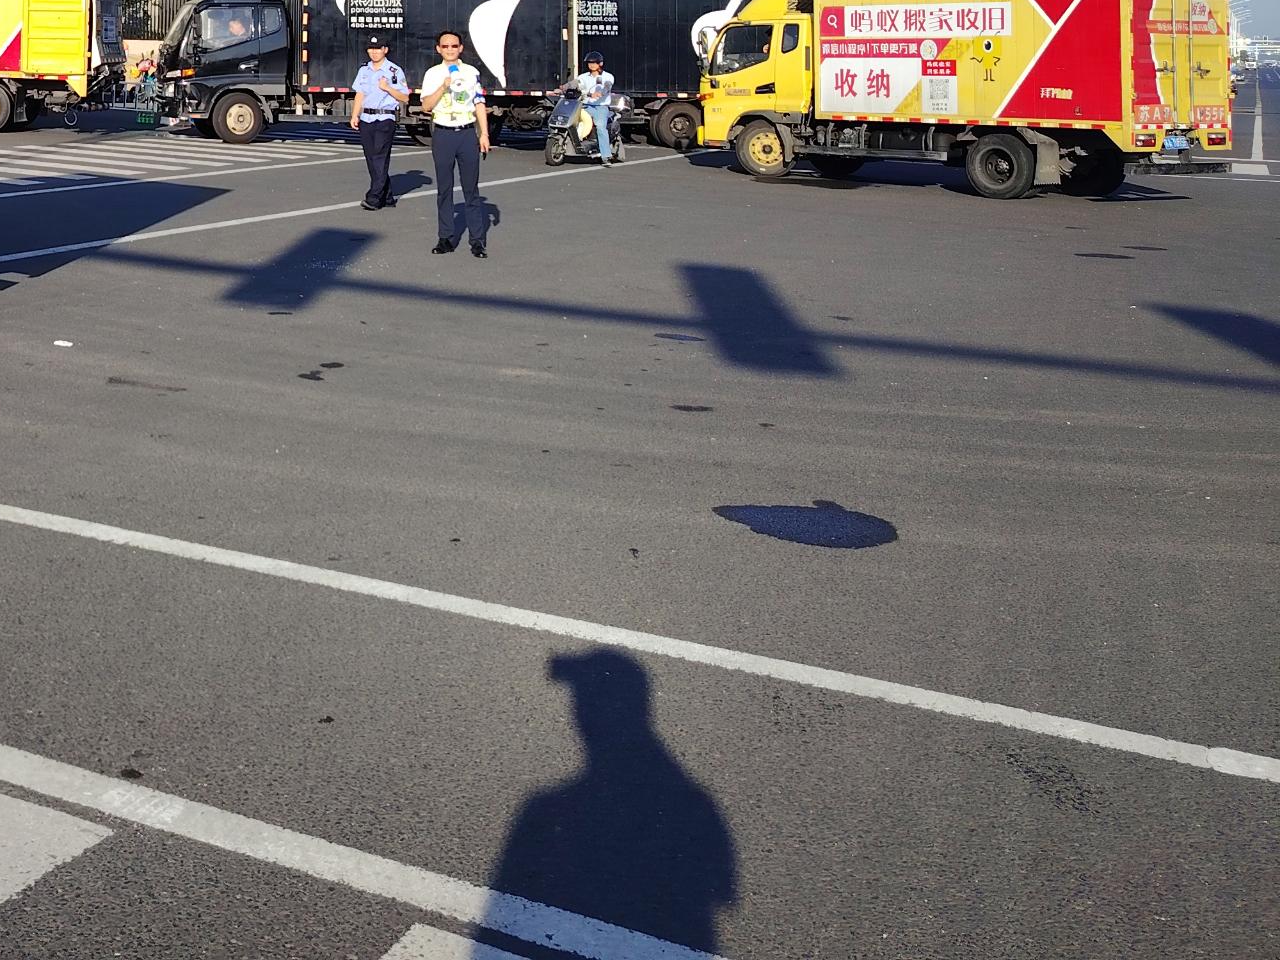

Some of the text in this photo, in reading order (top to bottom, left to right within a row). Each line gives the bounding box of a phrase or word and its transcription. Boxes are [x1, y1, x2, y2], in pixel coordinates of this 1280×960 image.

[850, 7, 1005, 33] 蚂蚁搬家收旧
[834, 68, 891, 98] 收纳
